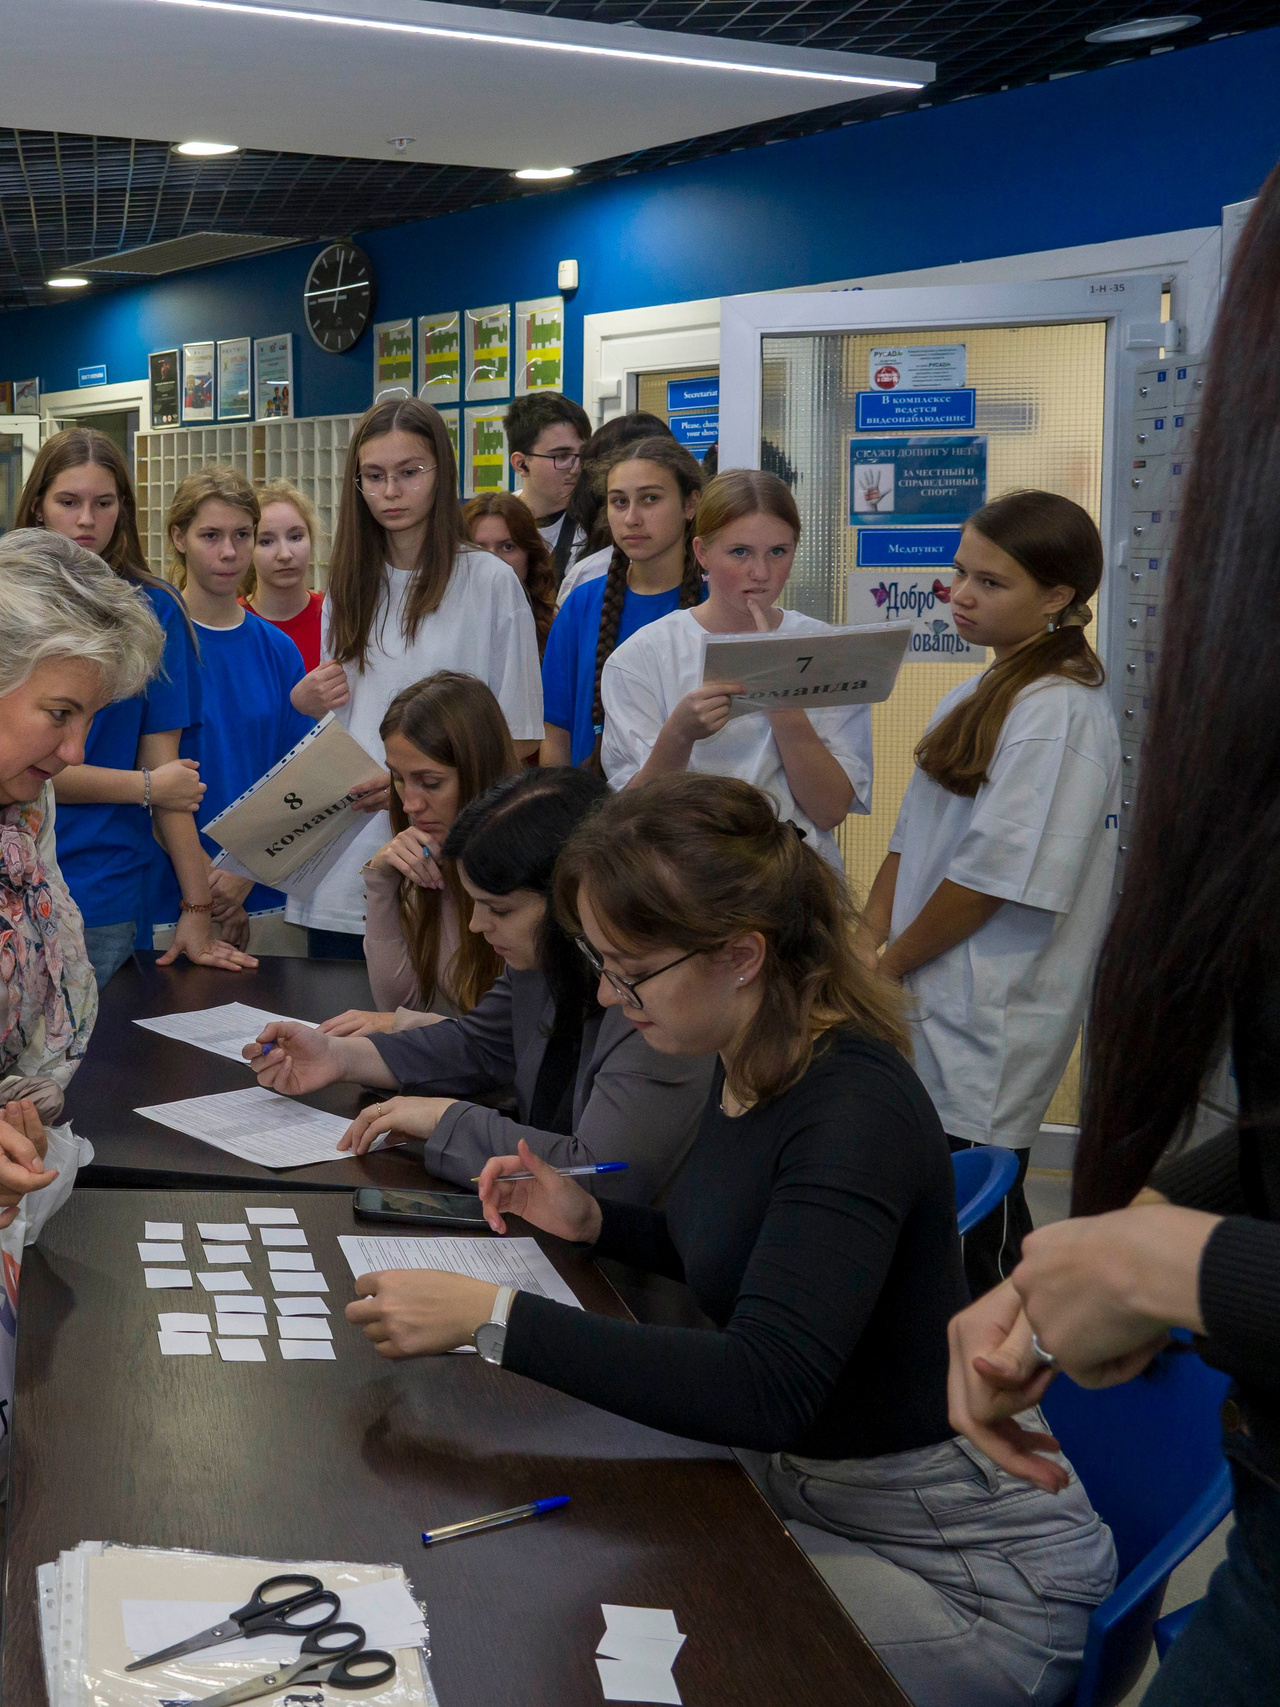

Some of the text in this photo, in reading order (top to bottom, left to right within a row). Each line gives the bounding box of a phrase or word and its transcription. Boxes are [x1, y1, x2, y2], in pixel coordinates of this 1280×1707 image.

[683, 389, 718, 399] Secretariat
[882, 395, 951, 404] В комплексе
[895, 406, 937, 414] ведется
[866, 414, 966, 424] видеонаблюдение
[856, 449, 895, 458] СКАЖИ
[897, 448, 949, 457] ДОПИНГУ
[903, 468, 975, 477] ЗА ЧЕСТНЫЙ И
[898, 477, 978, 487] СПРАВЕДЛИВЫЙ
[920, 488, 957, 496] СПОРТ!
[888, 544, 944, 555] Медпункт
[886, 582, 935, 620] Добро
[796, 656, 814, 674] 7
[737, 680, 868, 700] оманда
[283, 792, 303, 810] 8
